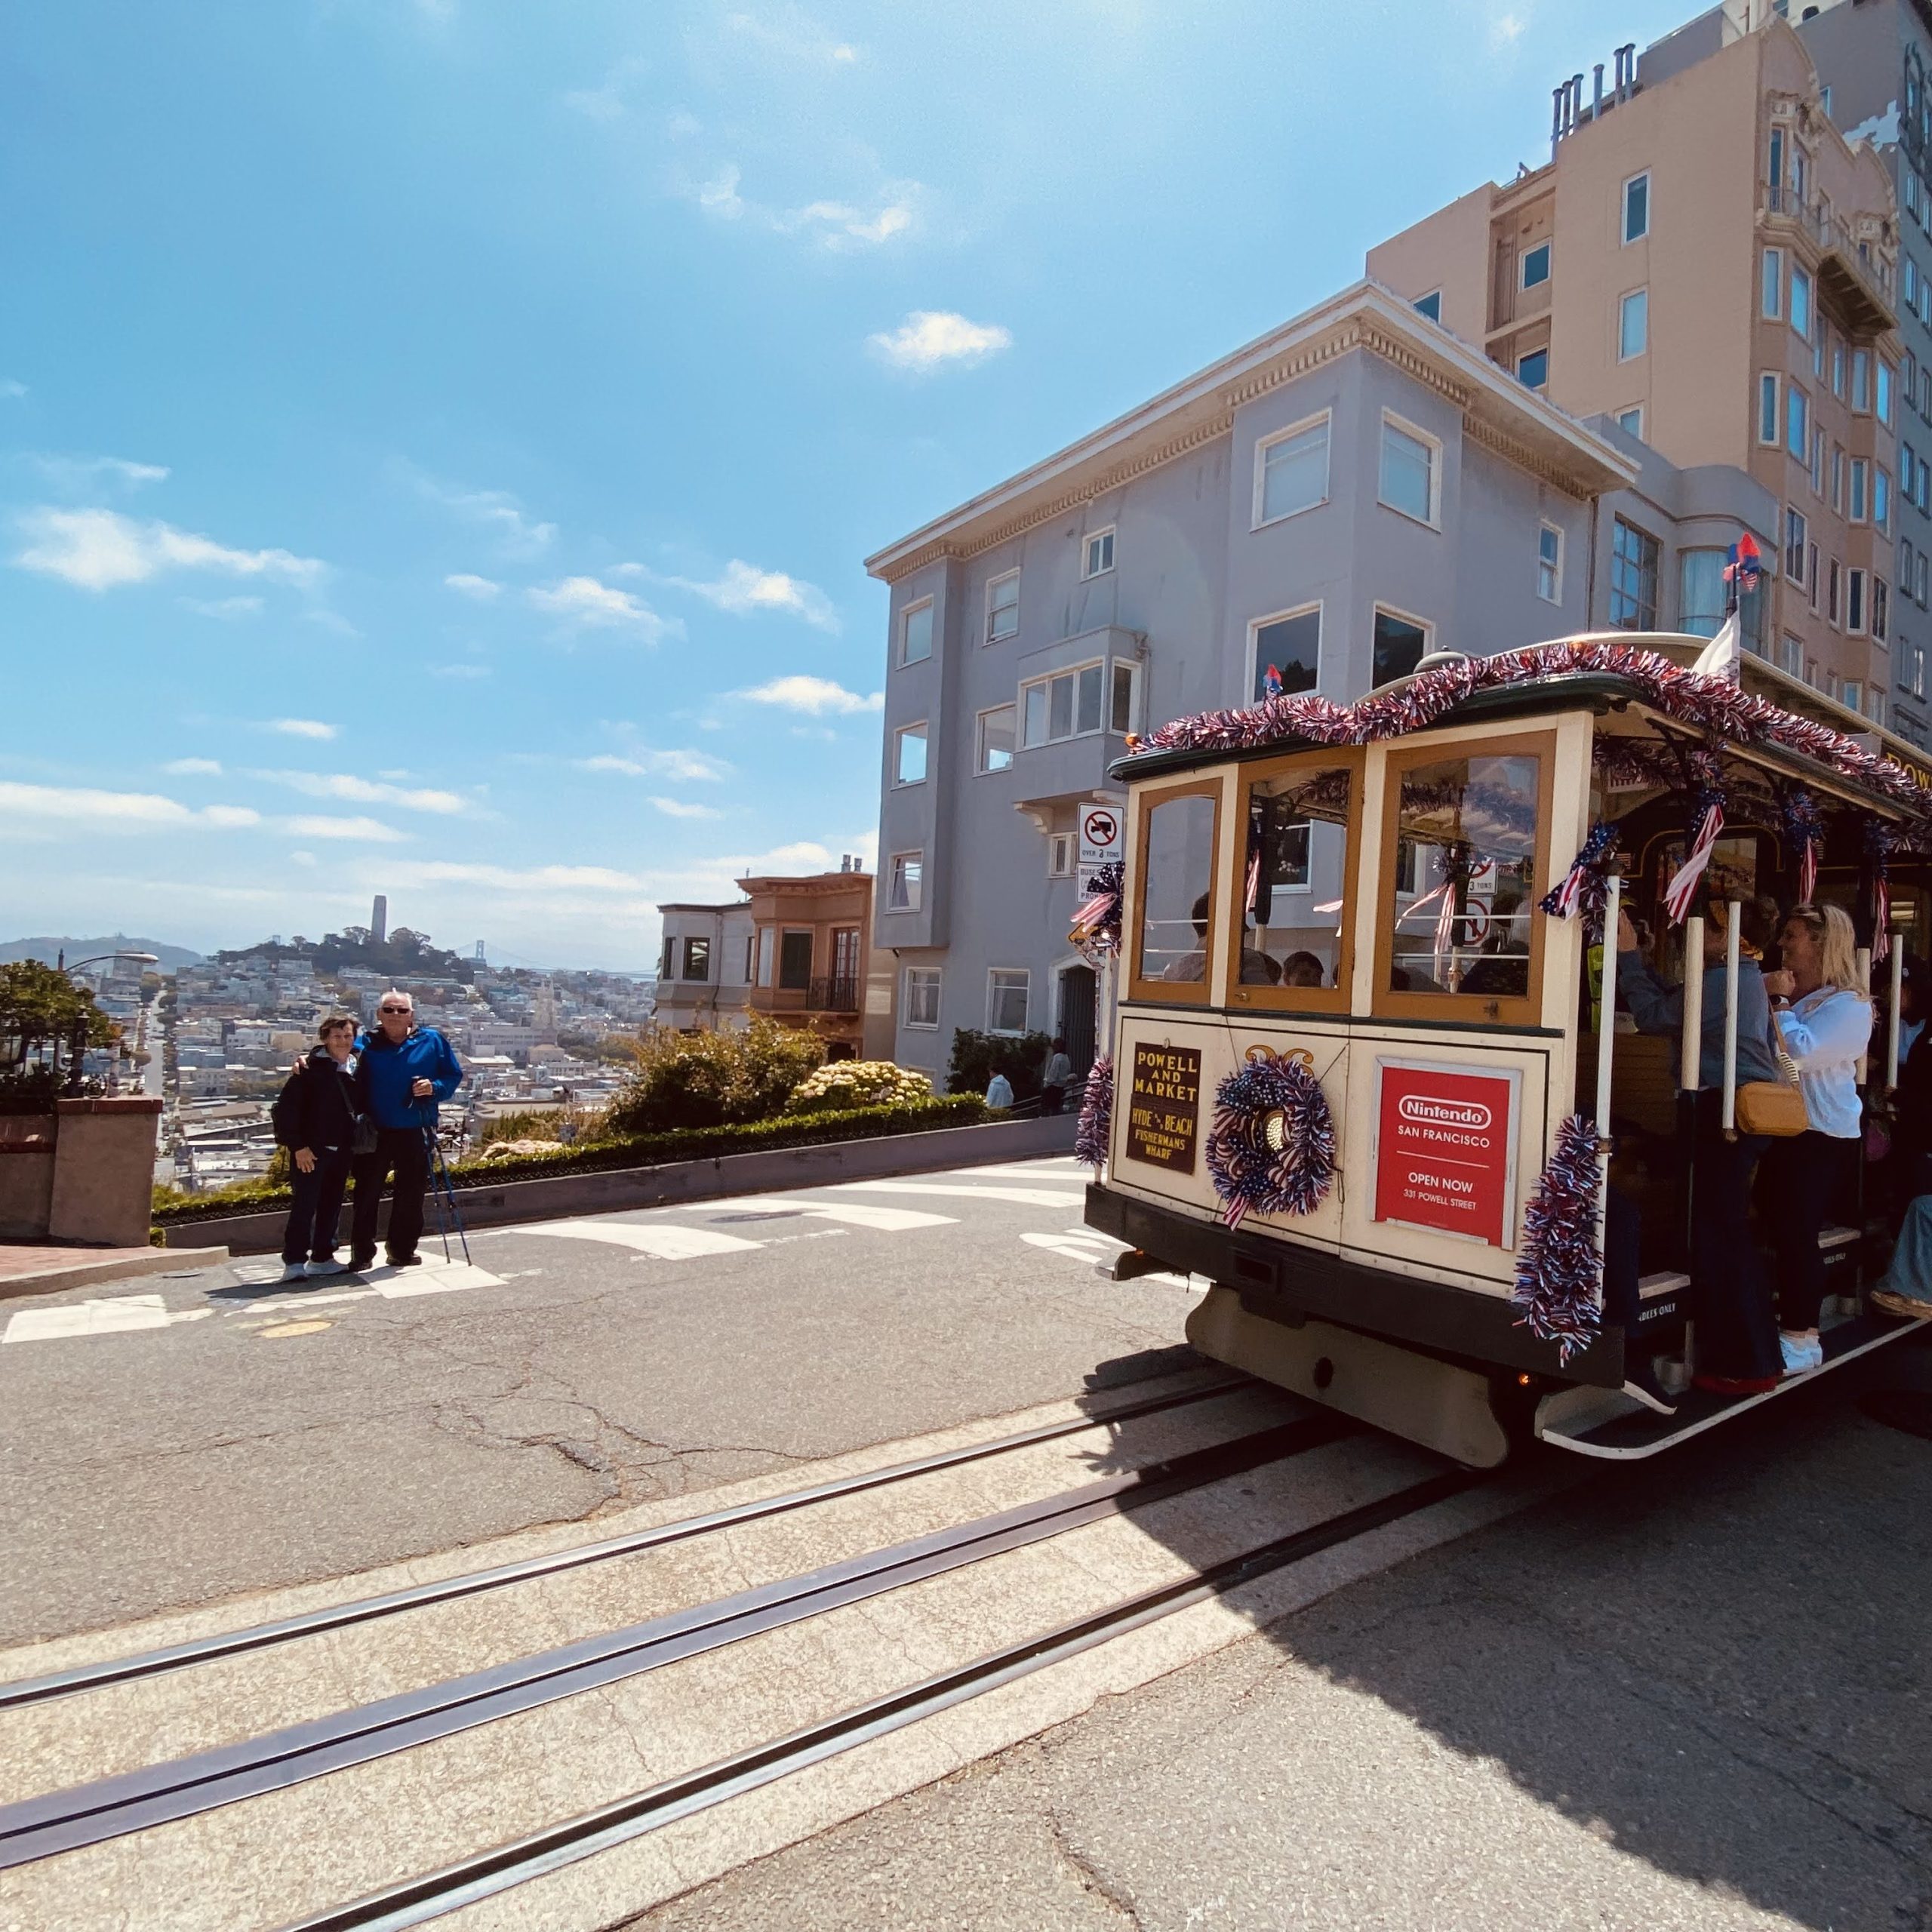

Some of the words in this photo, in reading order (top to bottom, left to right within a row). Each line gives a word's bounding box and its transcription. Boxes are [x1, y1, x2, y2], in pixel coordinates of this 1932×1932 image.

[1469, 881, 1475, 891] 3
[1138, 1051, 1197, 1073] POWELL
[1152, 1070, 1180, 1083] AND
[1135, 1078, 1197, 1102] MARKET
[1132, 1108, 1153, 1127] HYDE
[1164, 1115, 1192, 1137] BEACH
[1407, 1101, 1483, 1124] Nintendo
[1135, 1129, 1186, 1151] FISHERMANS
[1398, 1124, 1420, 1138] SAN
[1423, 1128, 1490, 1149] FRANCISCO
[1146, 1144, 1172, 1160] WHARF
[1408, 1172, 1439, 1188] OPEN
[1442, 1177, 1473, 1193] NOW
[1404, 1189, 1416, 1199] 331
[1418, 1192, 1448, 1205] POWELL
[1451, 1198, 1476, 1211] STREET
